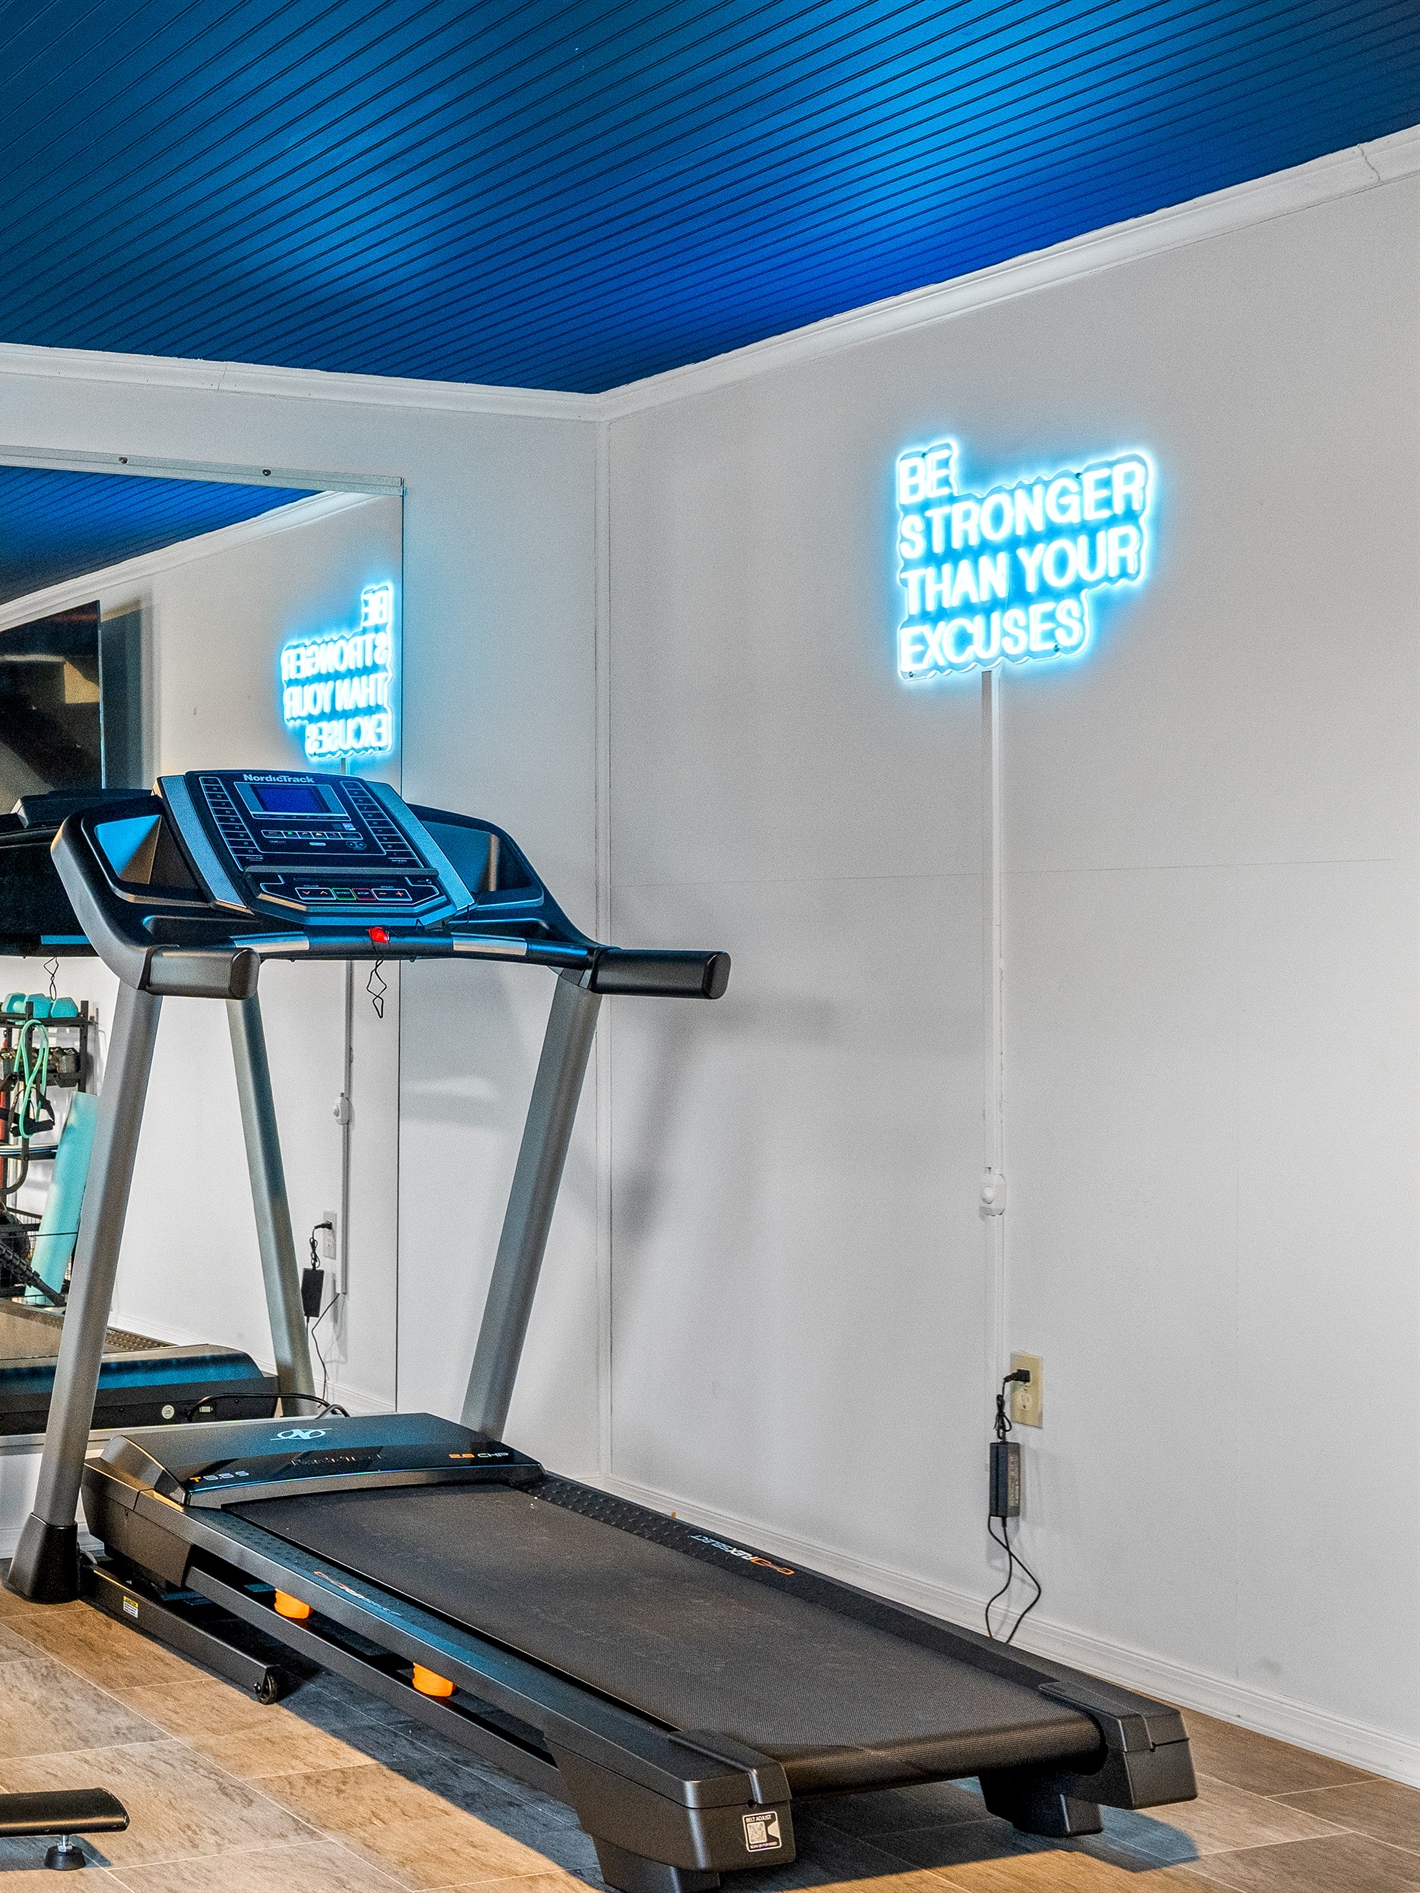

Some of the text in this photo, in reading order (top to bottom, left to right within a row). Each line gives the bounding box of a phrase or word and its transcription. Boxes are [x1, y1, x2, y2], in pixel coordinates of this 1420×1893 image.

[898, 448, 952, 505] BE
[899, 461, 1146, 560] STRONGER
[900, 524, 1141, 616] THAN YOUR
[899, 598, 1082, 673] EXCUSES
[242, 773, 316, 784] NordicTrack
